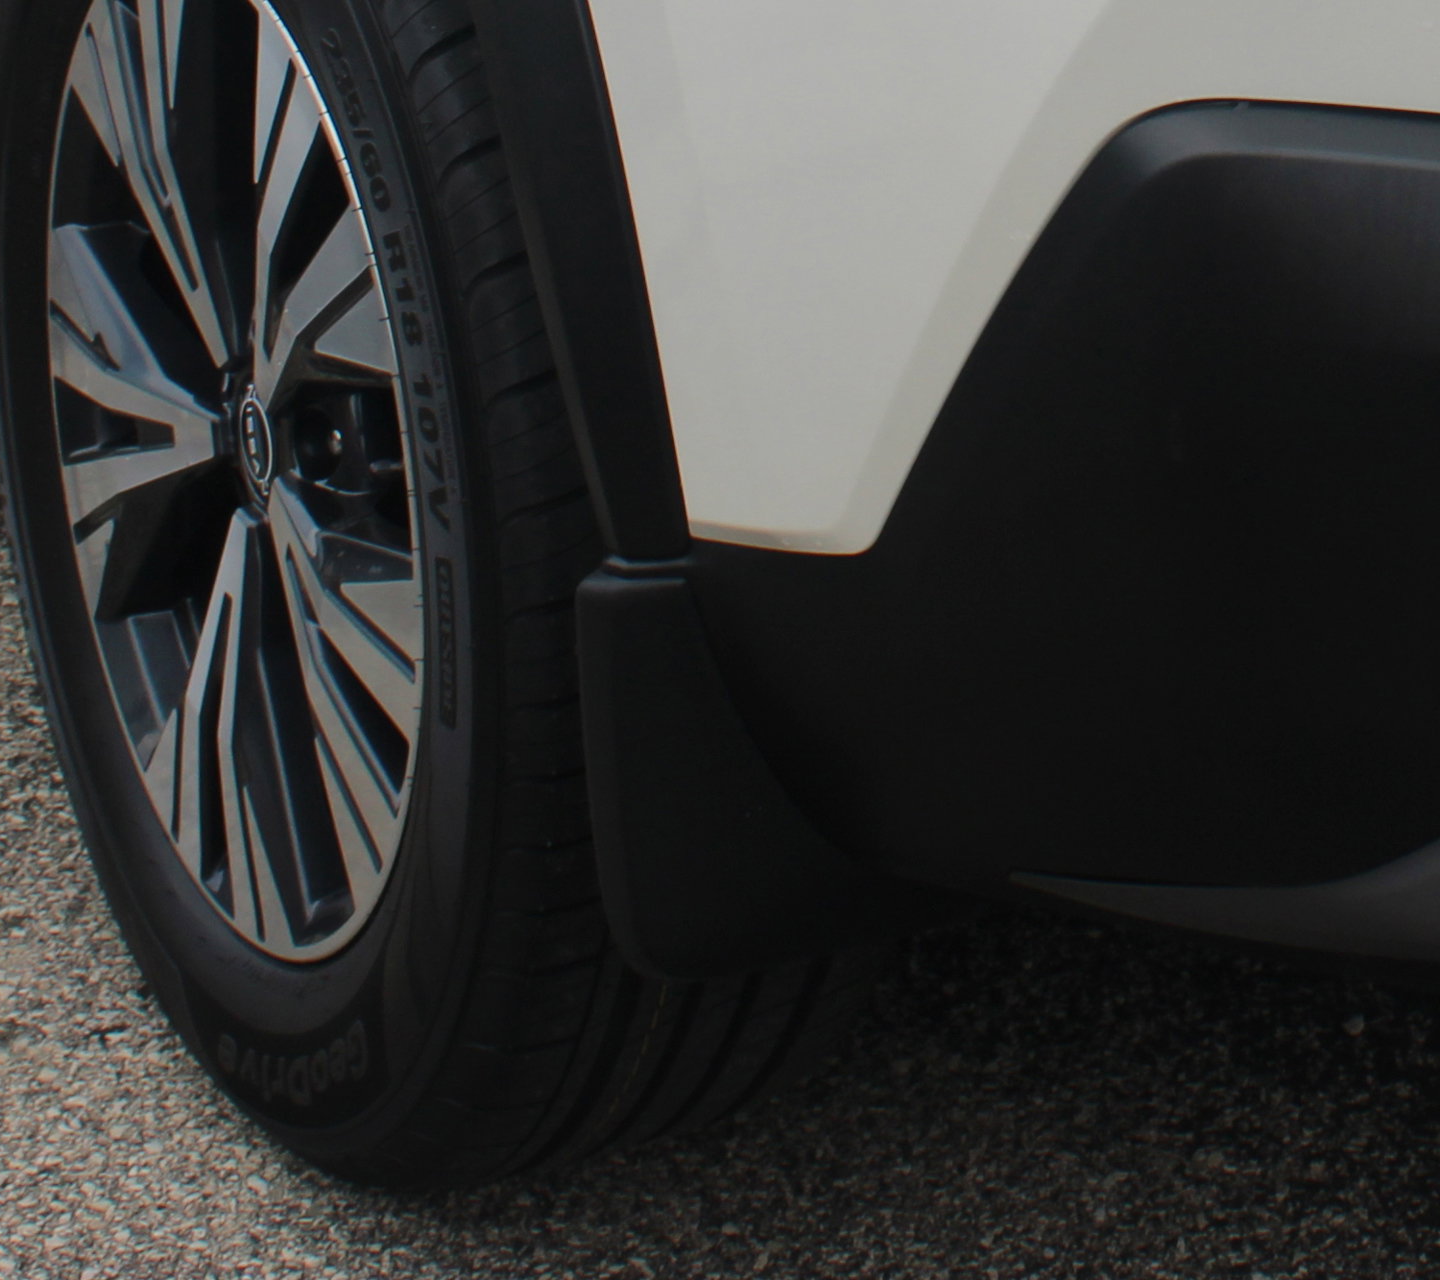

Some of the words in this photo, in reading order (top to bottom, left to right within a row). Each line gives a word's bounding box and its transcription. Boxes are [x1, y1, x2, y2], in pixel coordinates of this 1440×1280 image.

[320, 26, 392, 213] 235/60
[382, 230, 424, 347] R18
[412, 372, 451, 532] 107V
[217, 1018, 369, 1107] GeoDrive
